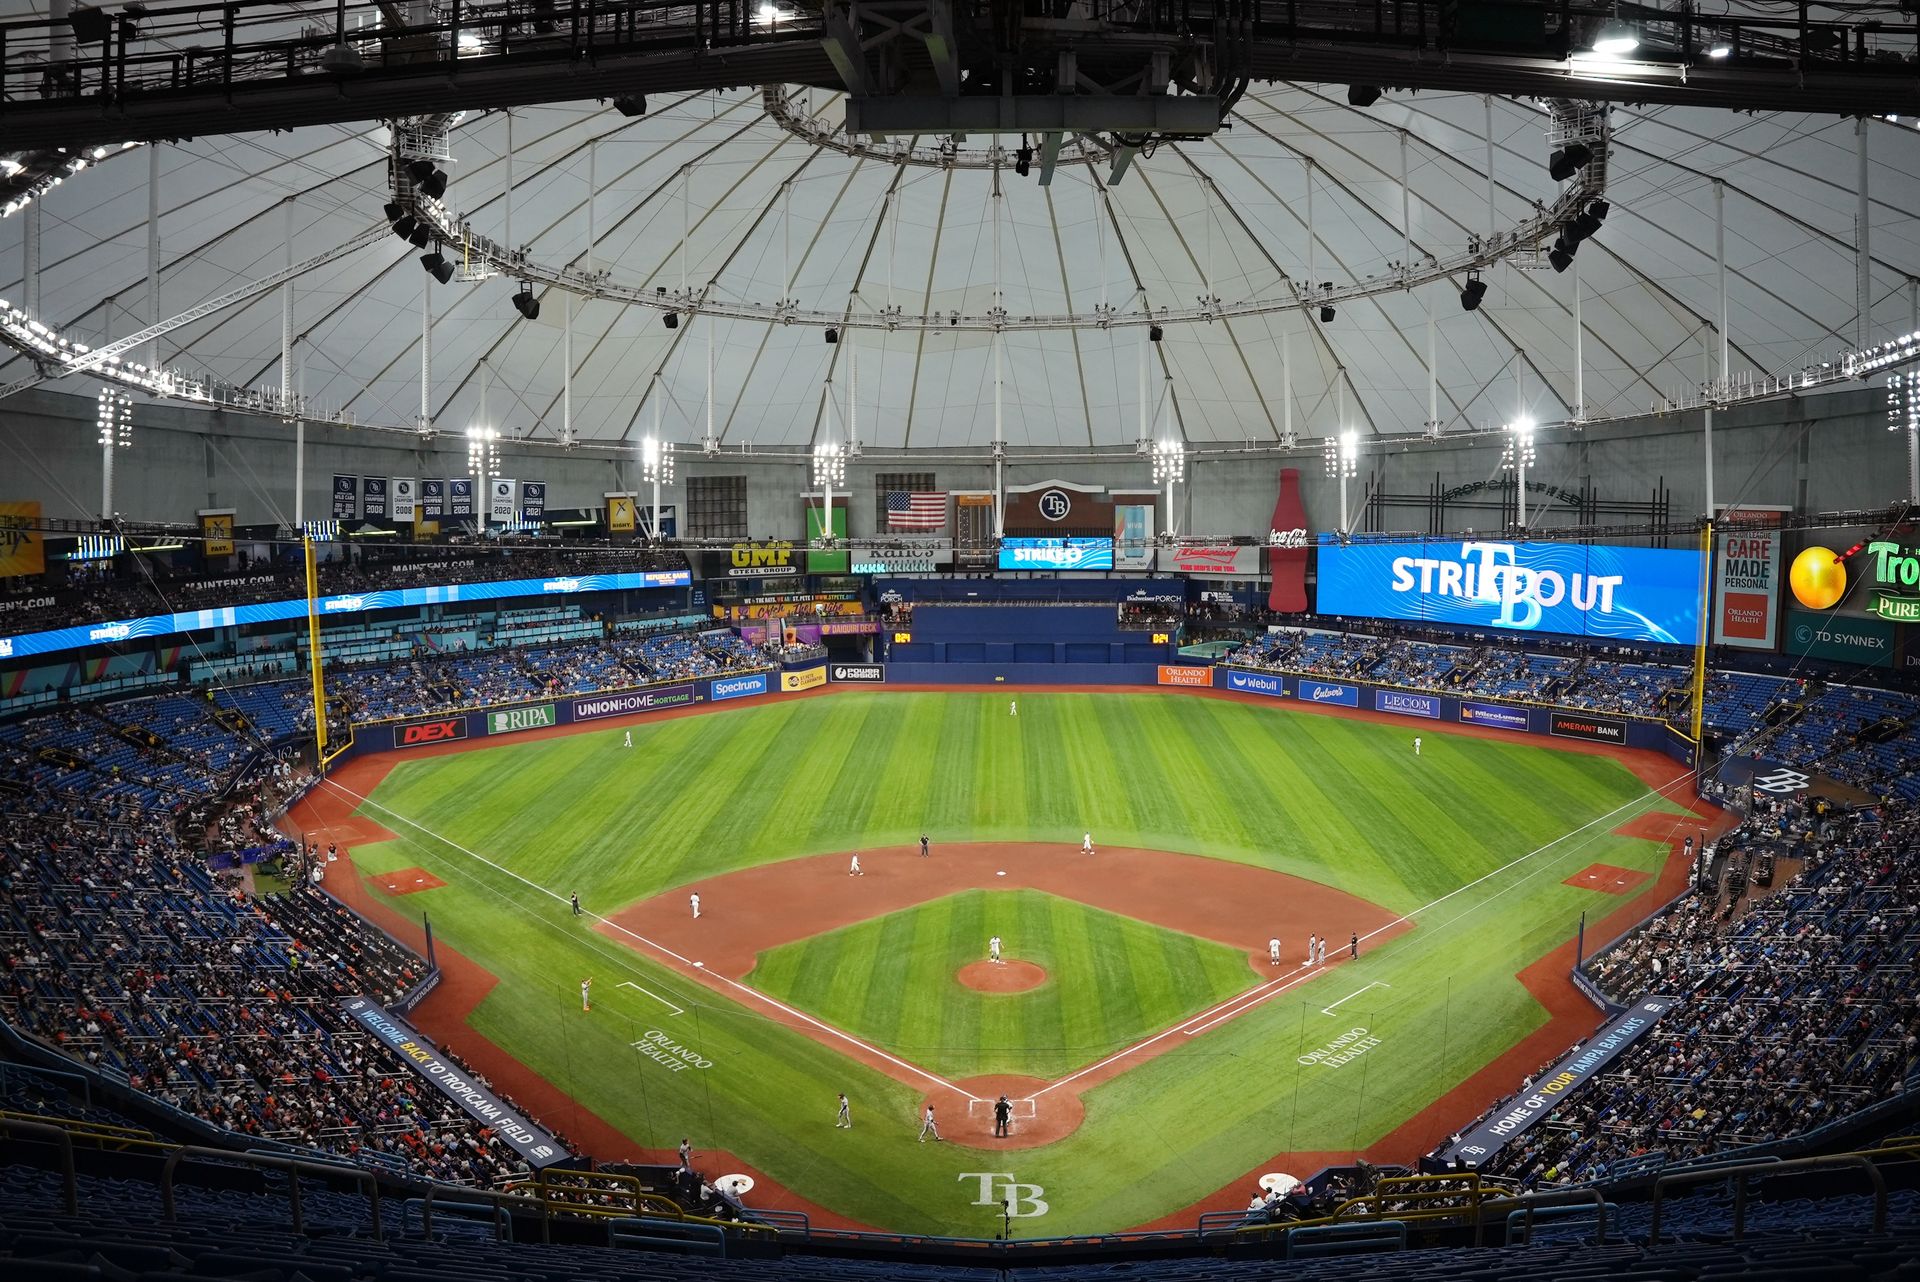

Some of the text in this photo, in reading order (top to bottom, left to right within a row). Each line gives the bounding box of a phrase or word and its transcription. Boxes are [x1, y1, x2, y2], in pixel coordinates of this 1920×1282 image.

[366, 505, 383, 514] 2008
[396, 506, 412, 514] 2008
[1045, 496, 1066, 514] TB
[1733, 511, 1768, 519] ORLANDO
[731, 541, 793, 567] GMF
[1727, 539, 1771, 559] CARE
[1725, 559, 1770, 578] MADE
[1868, 541, 1920, 592] Tro
[1725, 578, 1769, 589] PERSONAL
[1727, 608, 1763, 617] ORLANDO
[1879, 597, 1919, 617] PURE
[1731, 615, 1759, 623] HEALTH
[832, 624, 876, 633] DAIQUIRI DECK
[1816, 631, 1884, 648] TD SYNNEX
[1166, 667, 1206, 676] ORLANDO
[1170, 675, 1201, 683] HEALTH
[715, 680, 757, 695] Spectrum
[1247, 677, 1277, 690] Webull
[1313, 686, 1344, 700] Culver's
[510, 708, 550, 729] RIPA
[404, 721, 457, 744] DEX
[1557, 721, 1619, 737] AMERANT BANK
[278, 746, 293, 759] 162
[644, 1030, 713, 1069] ORLANDO
[1297, 1027, 1368, 1065] ORLANDO
[1321, 1036, 1382, 1068] HEALTH
[630, 1039, 689, 1072] HEALTH
[359, 1009, 534, 1144] WELCOME BACK TO TROPICANA FIELD
[1489, 1017, 1645, 1136] HOME OF YOUR TAMPA BAY RAYS
[1461, 1146, 1486, 1155] TB
[958, 1173, 1049, 1218] TB
